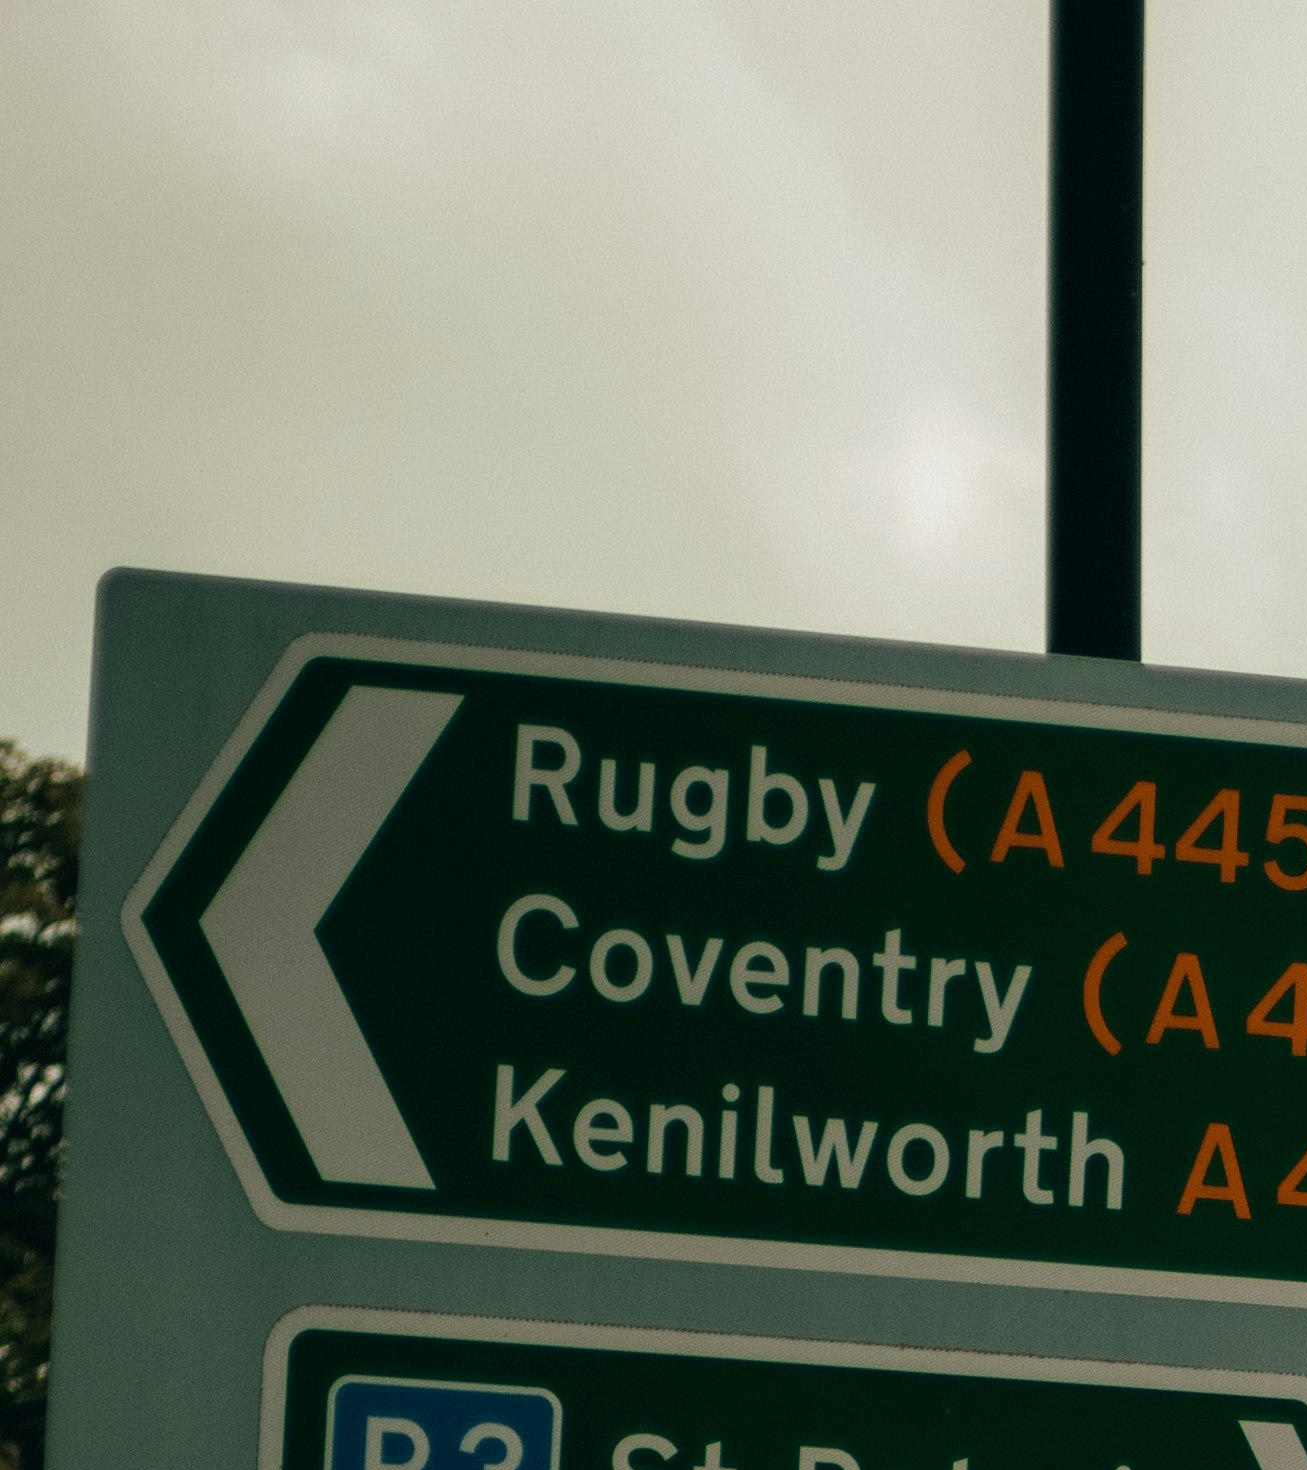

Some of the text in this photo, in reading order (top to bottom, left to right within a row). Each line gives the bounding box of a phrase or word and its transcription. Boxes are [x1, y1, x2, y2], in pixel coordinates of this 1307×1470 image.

[514, 725, 875, 870] Rugby
[498, 895, 1031, 1053] Coventry
[494, 1065, 1124, 1209] Kenilworth
